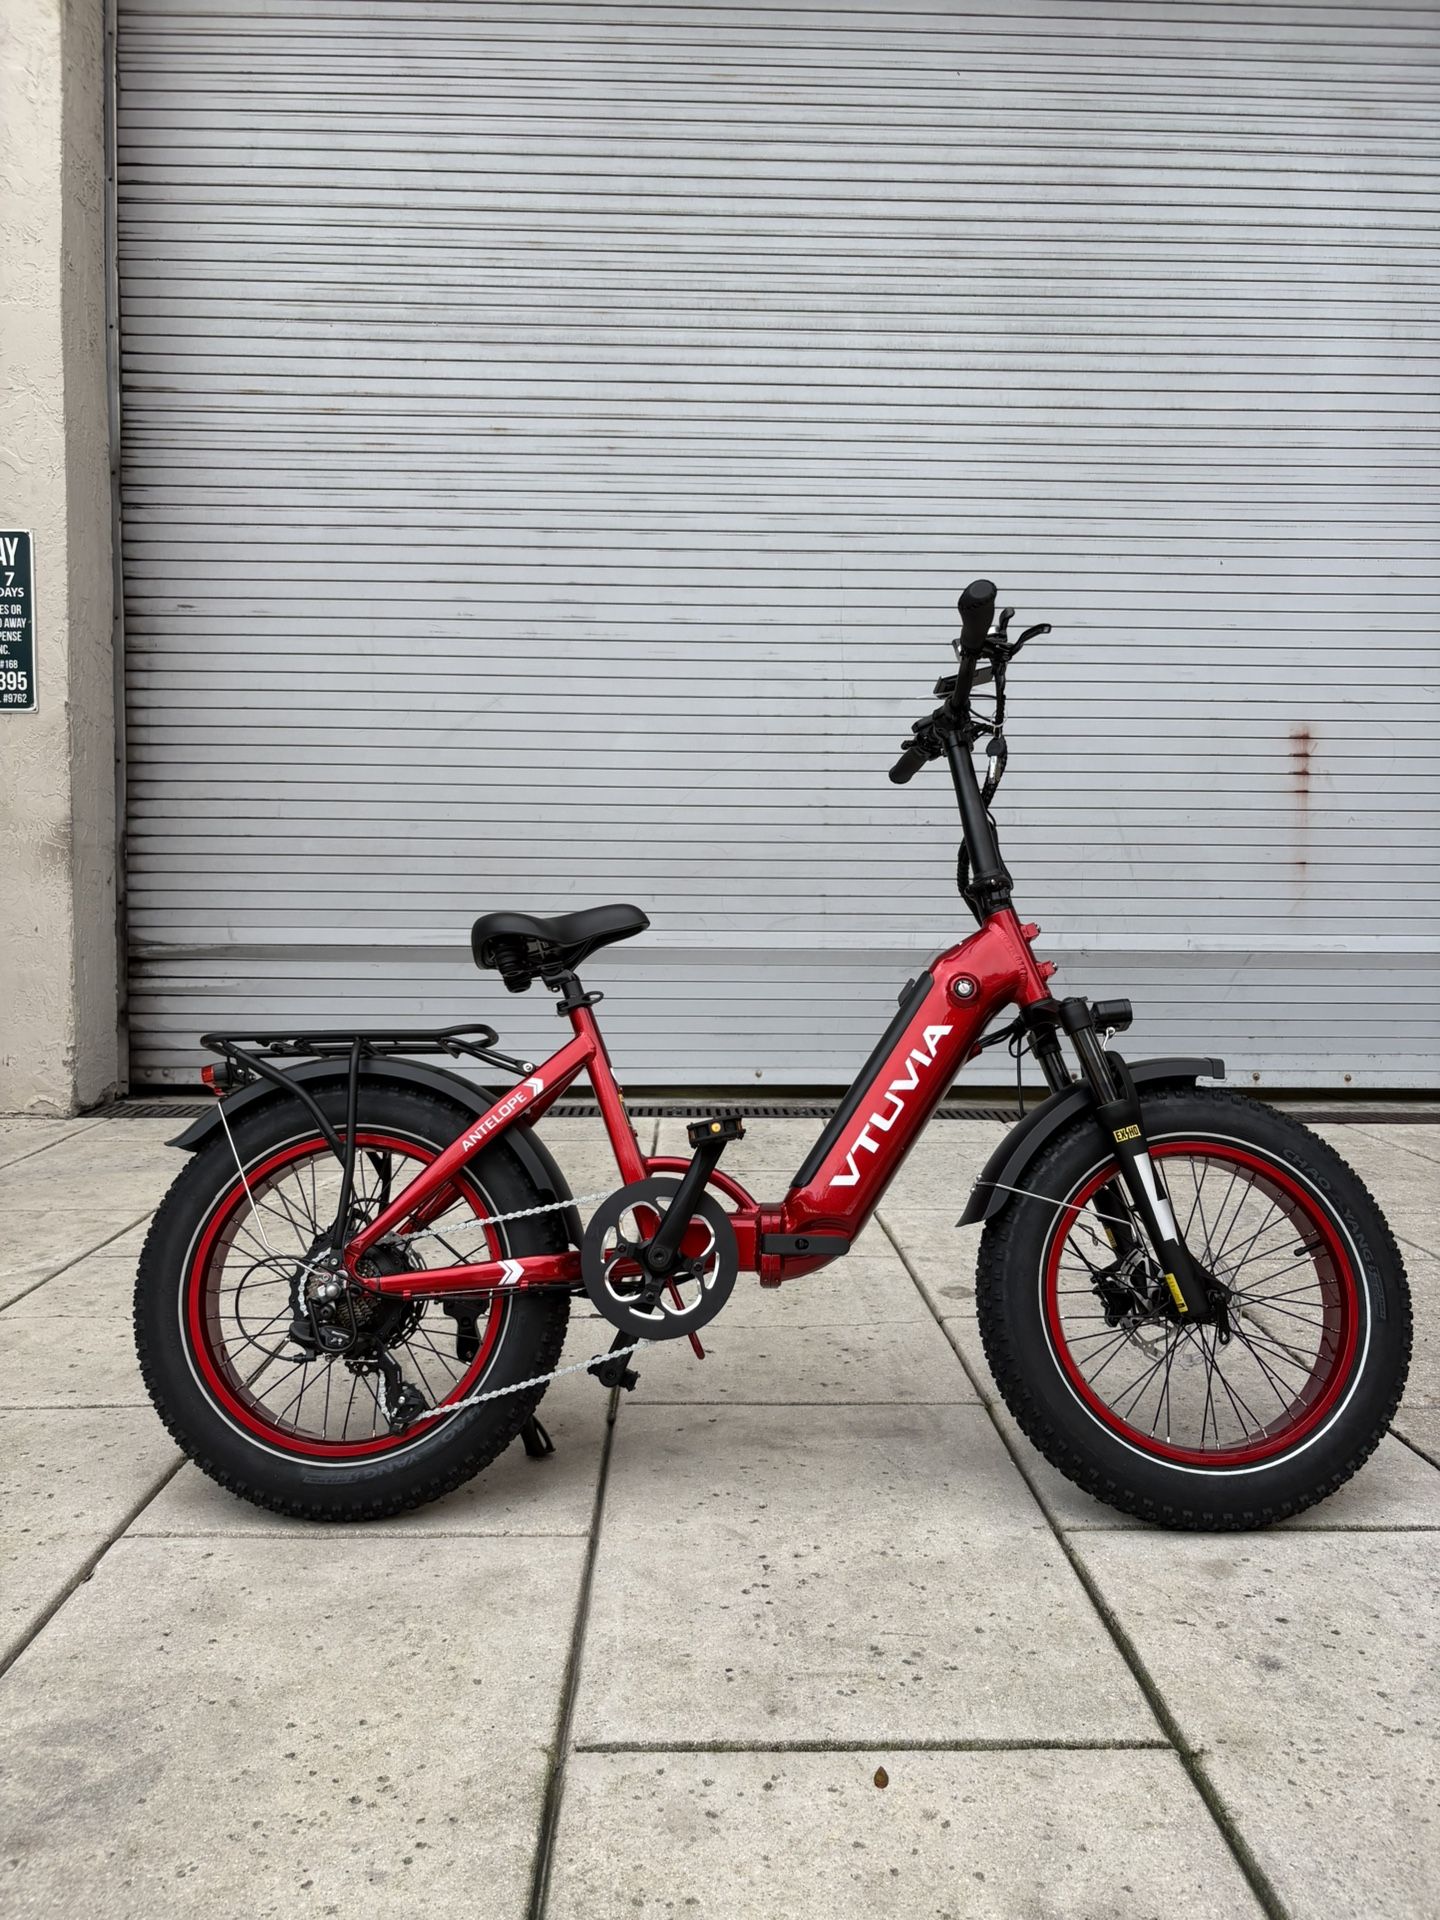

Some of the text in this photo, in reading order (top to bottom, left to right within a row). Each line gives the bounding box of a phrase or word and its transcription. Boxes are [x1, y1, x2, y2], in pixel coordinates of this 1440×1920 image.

[4, 571, 15, 587] 7
[4, 617, 27, 628] AWAY
[10, 604, 22, 615] OR
[461, 1091, 528, 1152] ANTELOPE
[829, 1025, 954, 1186] VTUVIA
[1282, 1148, 1375, 1262] CHAO YANG
